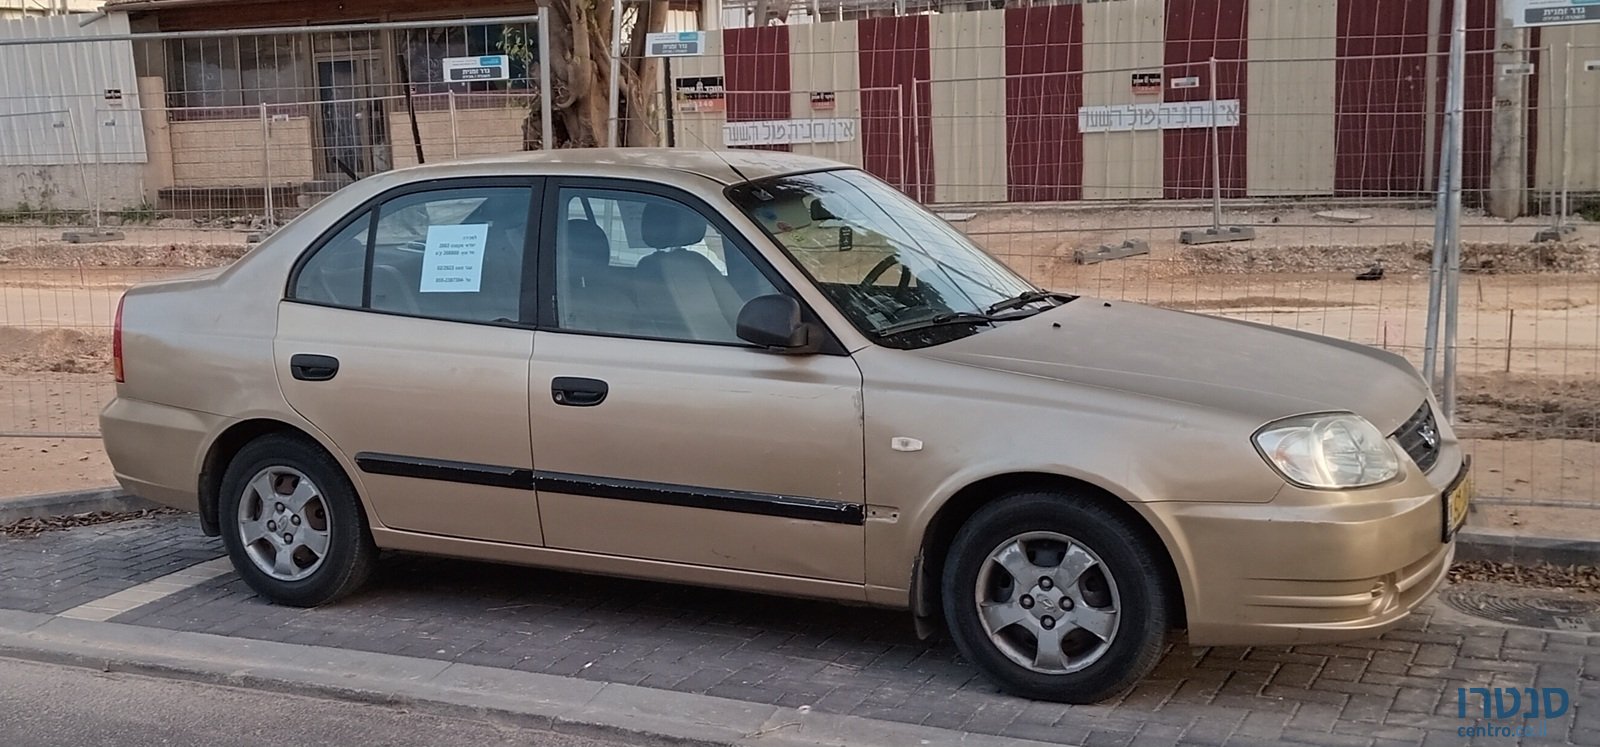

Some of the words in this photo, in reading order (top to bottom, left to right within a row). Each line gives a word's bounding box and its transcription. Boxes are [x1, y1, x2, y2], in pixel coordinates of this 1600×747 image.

[1543, 8, 1568, 16] זמנית
[1080, 109, 1122, 128] השער
[1127, 105, 1155, 126] מול
[1158, 106, 1203, 125] חניה
[722, 125, 758, 141] השער
[762, 122, 786, 140] מול
[832, 121, 853, 139] אין
